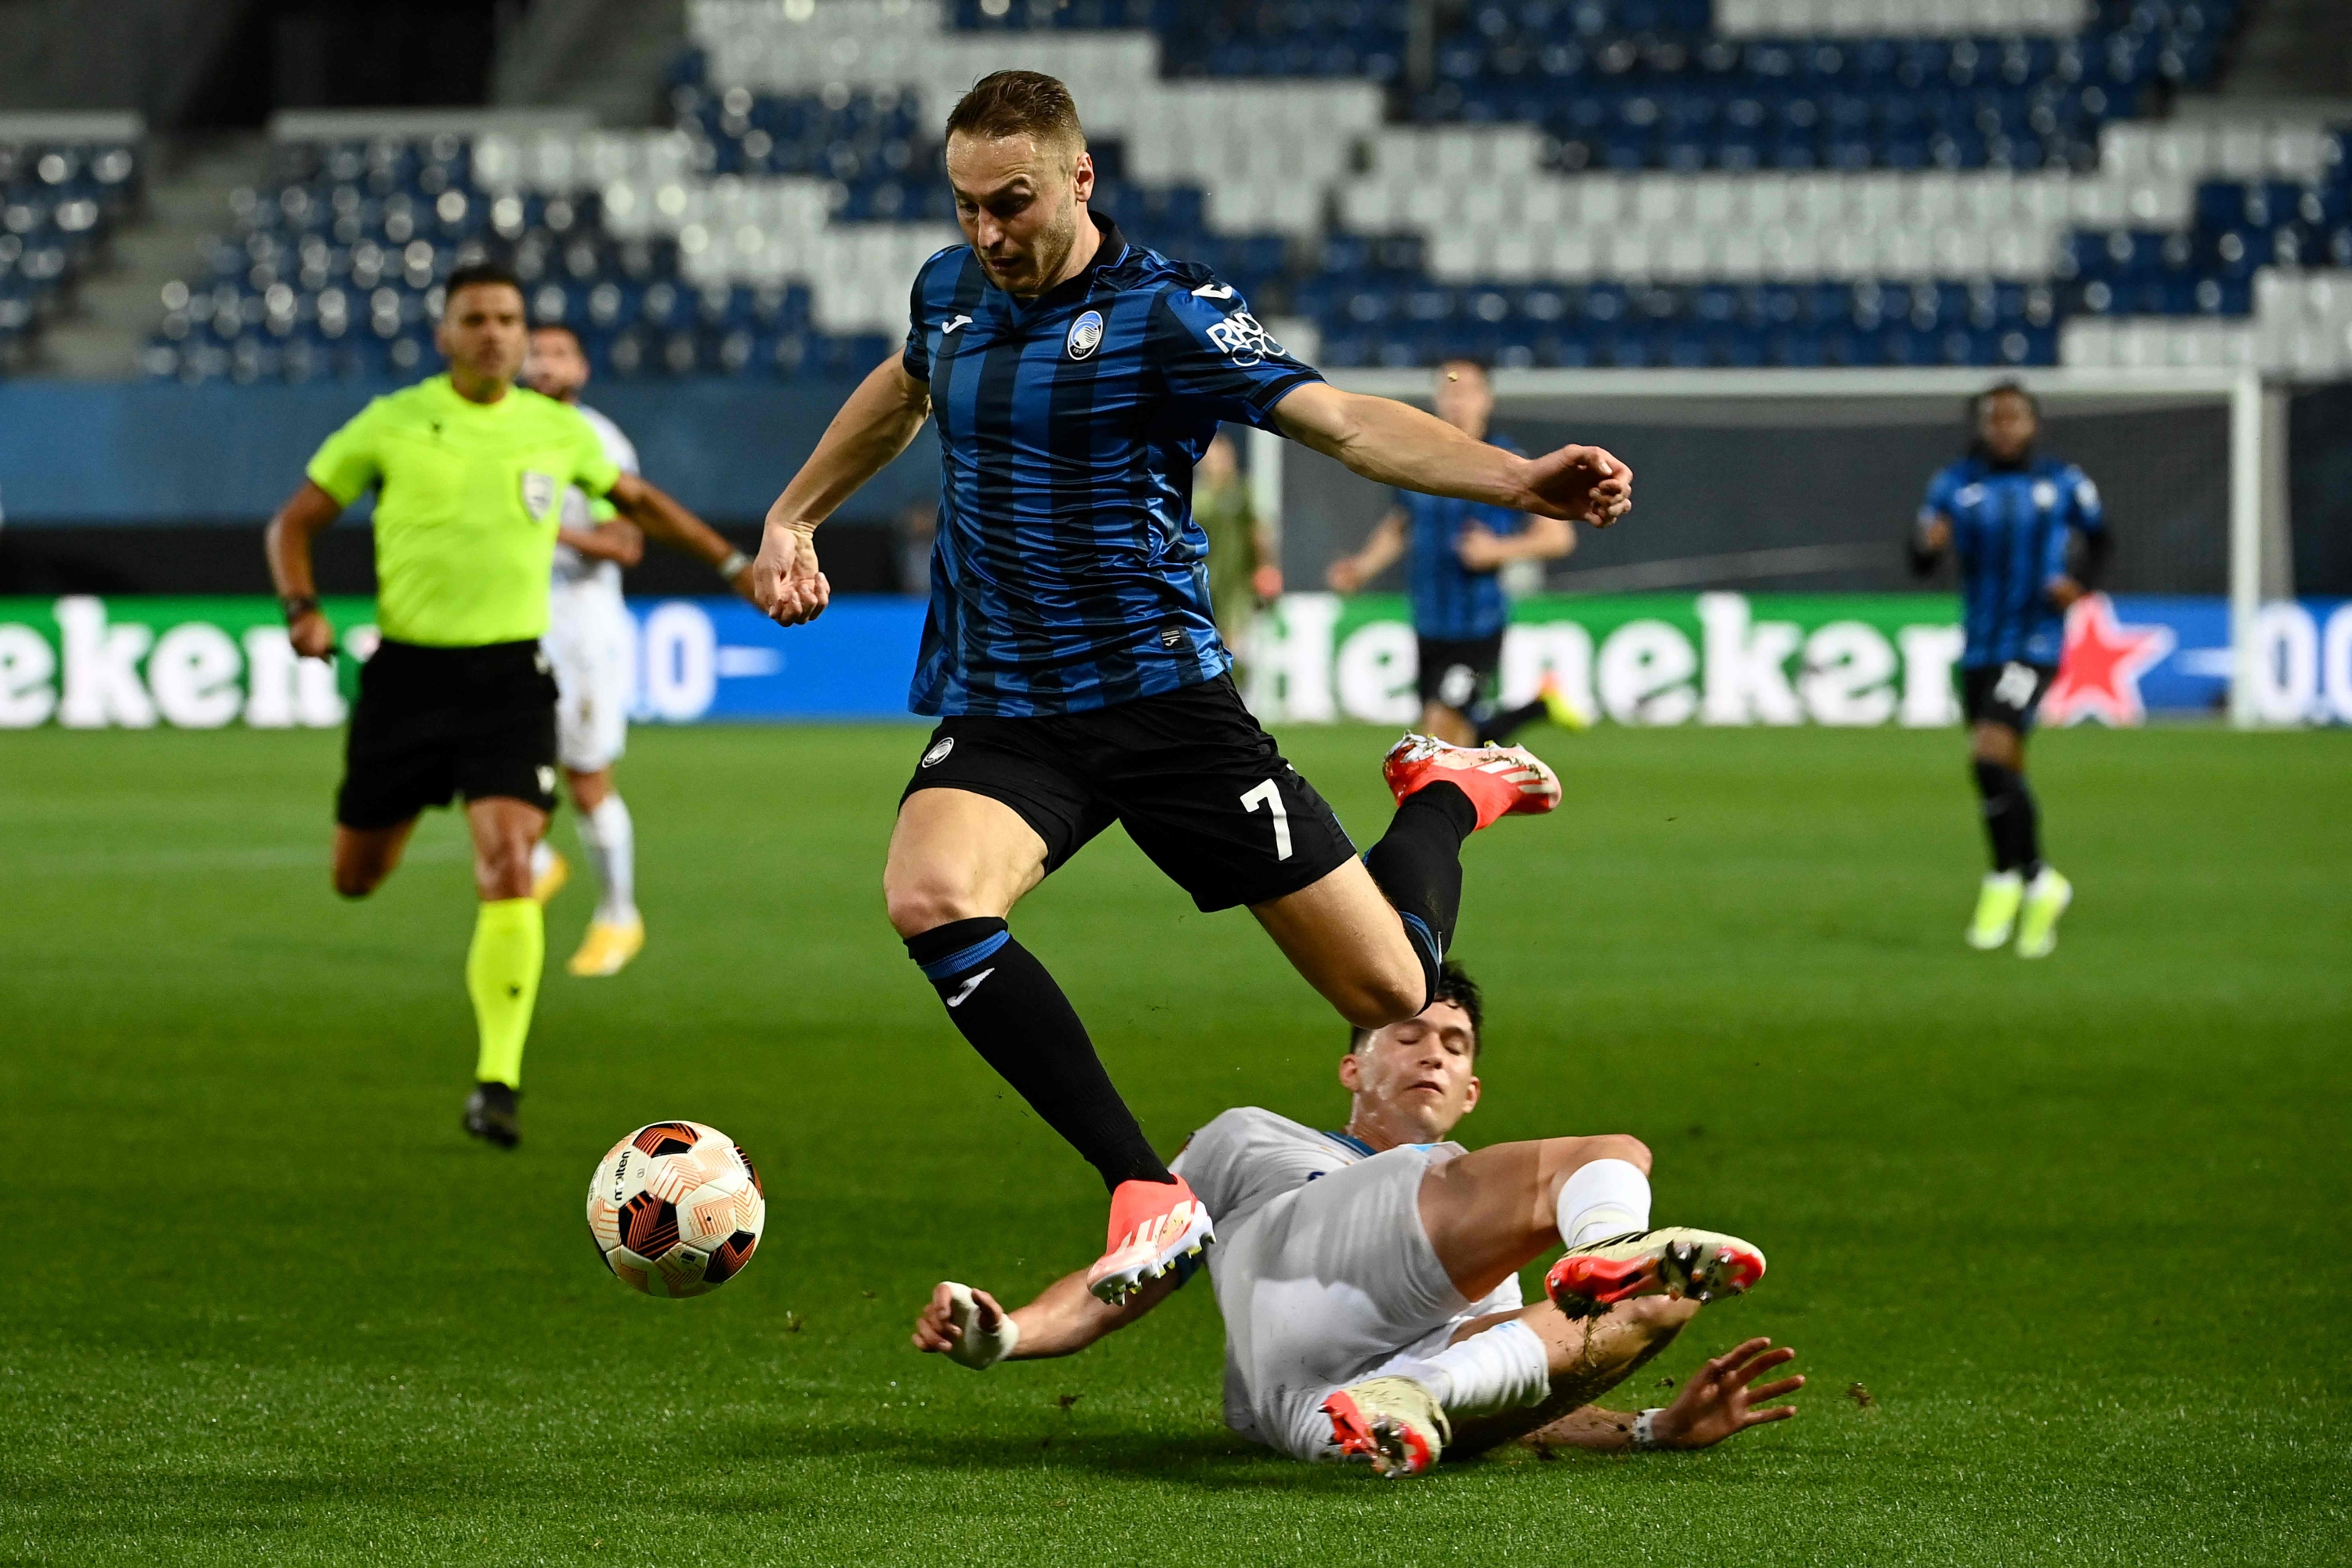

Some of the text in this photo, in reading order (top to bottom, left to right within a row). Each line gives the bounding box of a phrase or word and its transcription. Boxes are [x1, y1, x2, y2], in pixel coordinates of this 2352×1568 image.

[0, 594, 350, 728] eken
[1240, 778, 1293, 861] 7
[614, 1150, 632, 1201] molten
